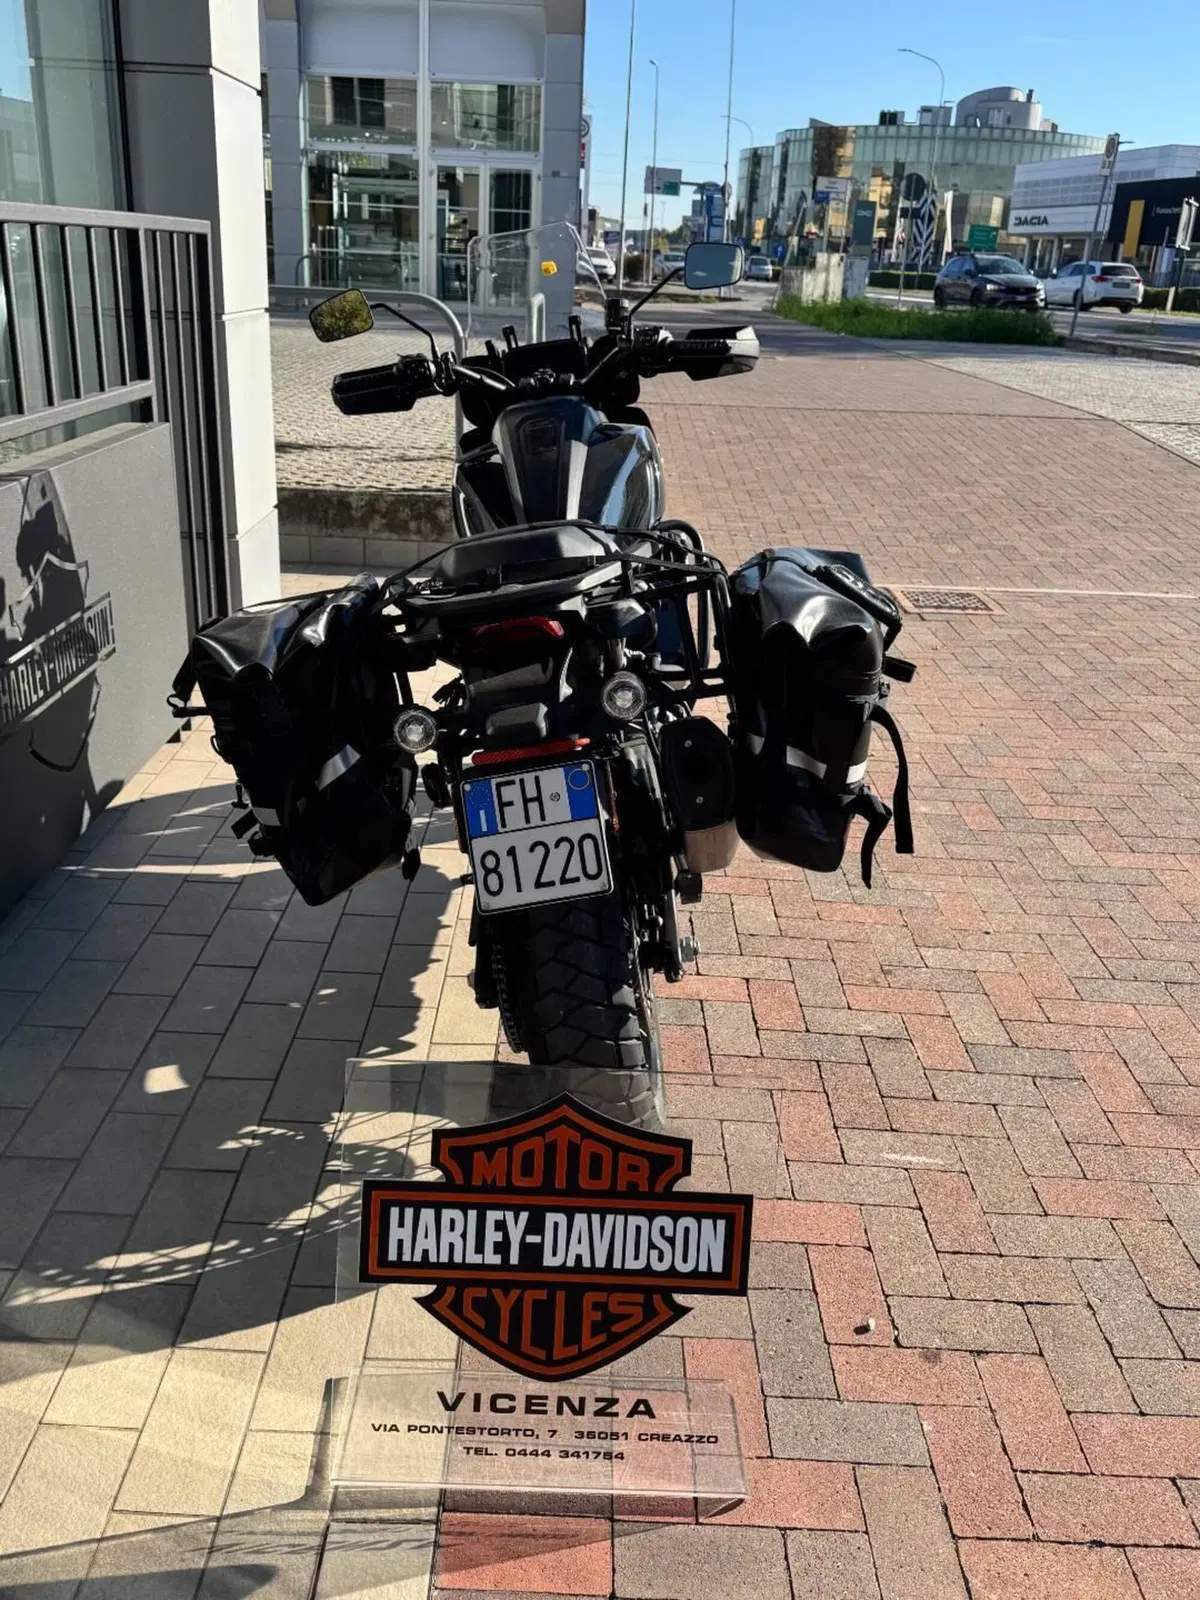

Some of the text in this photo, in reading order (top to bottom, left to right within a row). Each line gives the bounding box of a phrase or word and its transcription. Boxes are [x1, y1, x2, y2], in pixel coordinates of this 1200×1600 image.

[1013, 215, 1049, 226] DACIA
[495, 775, 546, 828] FH
[480, 833, 603, 897] 81220
[471, 1124, 651, 1193] MOTOR
[386, 1206, 727, 1274] HARLEY-DAVIDSON
[462, 1285, 645, 1361] CYCLES
[436, 1390, 657, 1420] VICENZA
[371, 1423, 719, 1444] VIA PONTESTORTO, 7 36051 CREAZZO
[463, 1446, 625, 1461] TEL. 0444 341754
